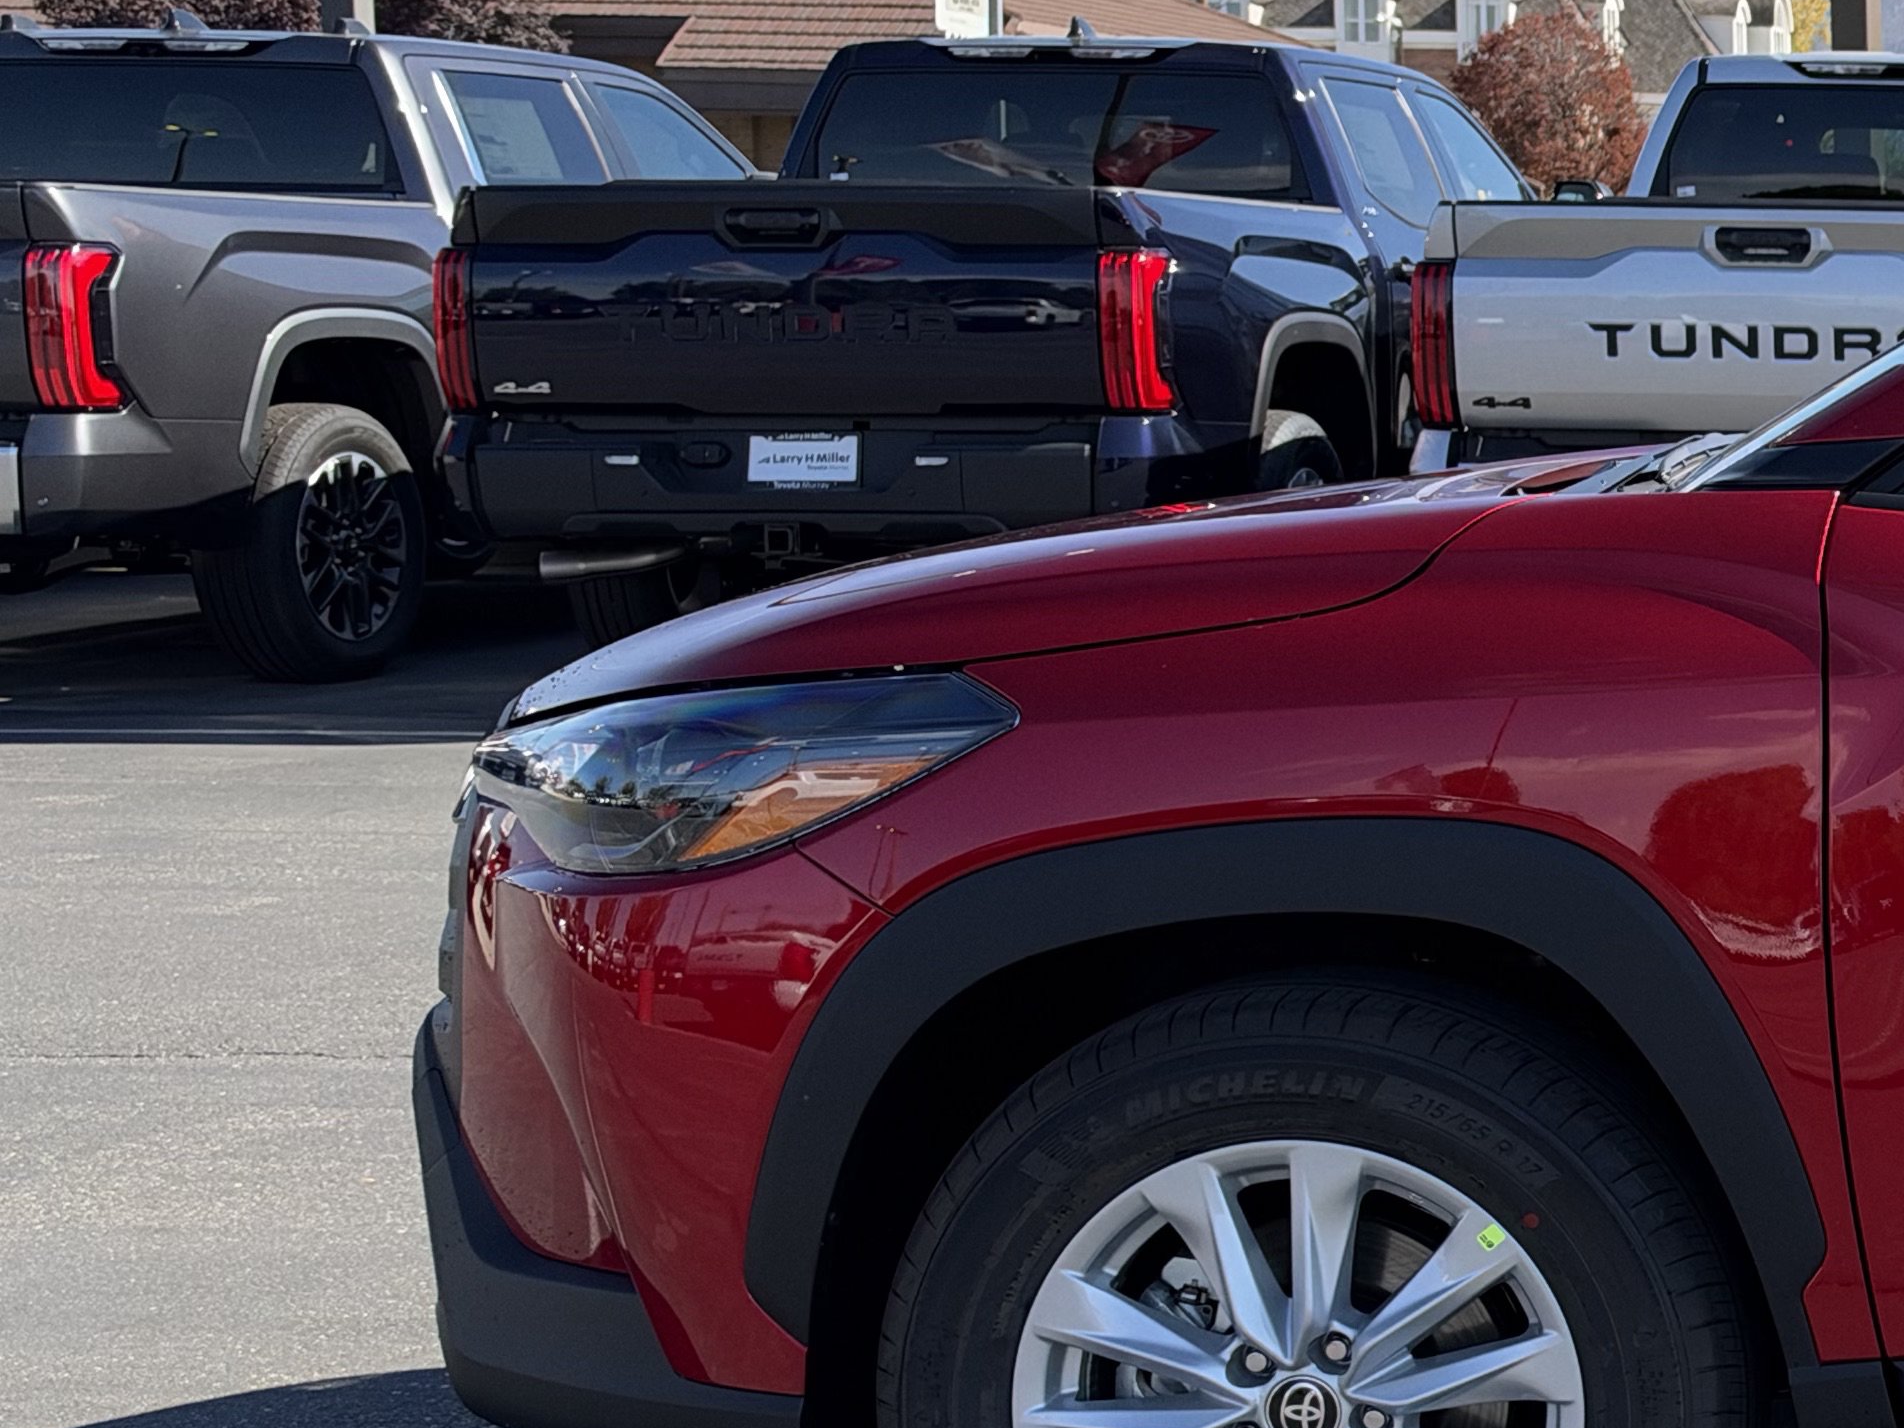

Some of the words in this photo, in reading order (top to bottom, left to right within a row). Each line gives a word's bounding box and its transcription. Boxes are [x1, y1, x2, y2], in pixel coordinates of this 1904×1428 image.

[598, 301, 958, 344] TUNDRA
[772, 453, 803, 466] Larry
[804, 453, 814, 463] H
[816, 451, 851, 463] Miller
[1125, 1069, 1363, 1128] MICHELIN
[1405, 1091, 1493, 1145] 215/65
[1495, 1138, 1514, 1158] R
[1516, 1154, 1544, 1178] 17
